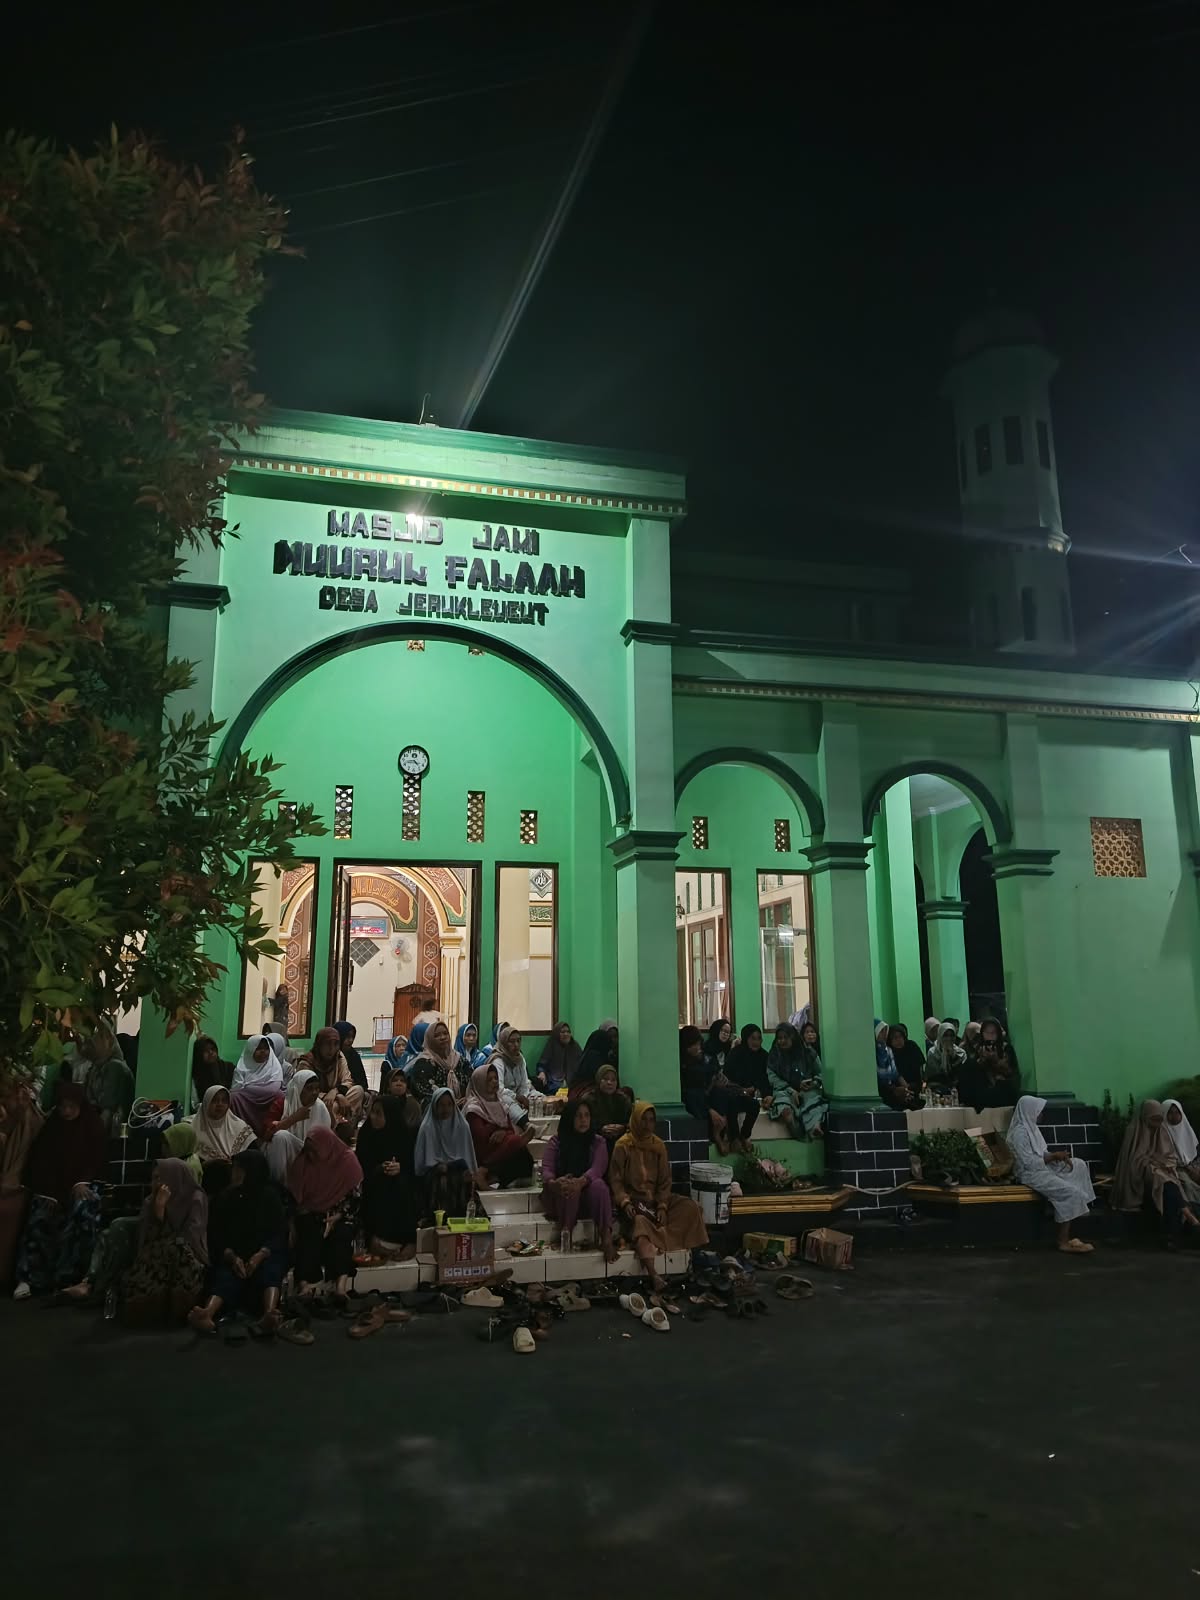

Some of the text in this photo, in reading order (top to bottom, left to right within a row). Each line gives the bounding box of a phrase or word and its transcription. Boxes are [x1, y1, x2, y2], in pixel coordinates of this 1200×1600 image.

[327, 510, 539, 555] MASJID JAMI
[273, 540, 585, 598] NUURUL FALAAH
[319, 585, 378, 613] DESA
